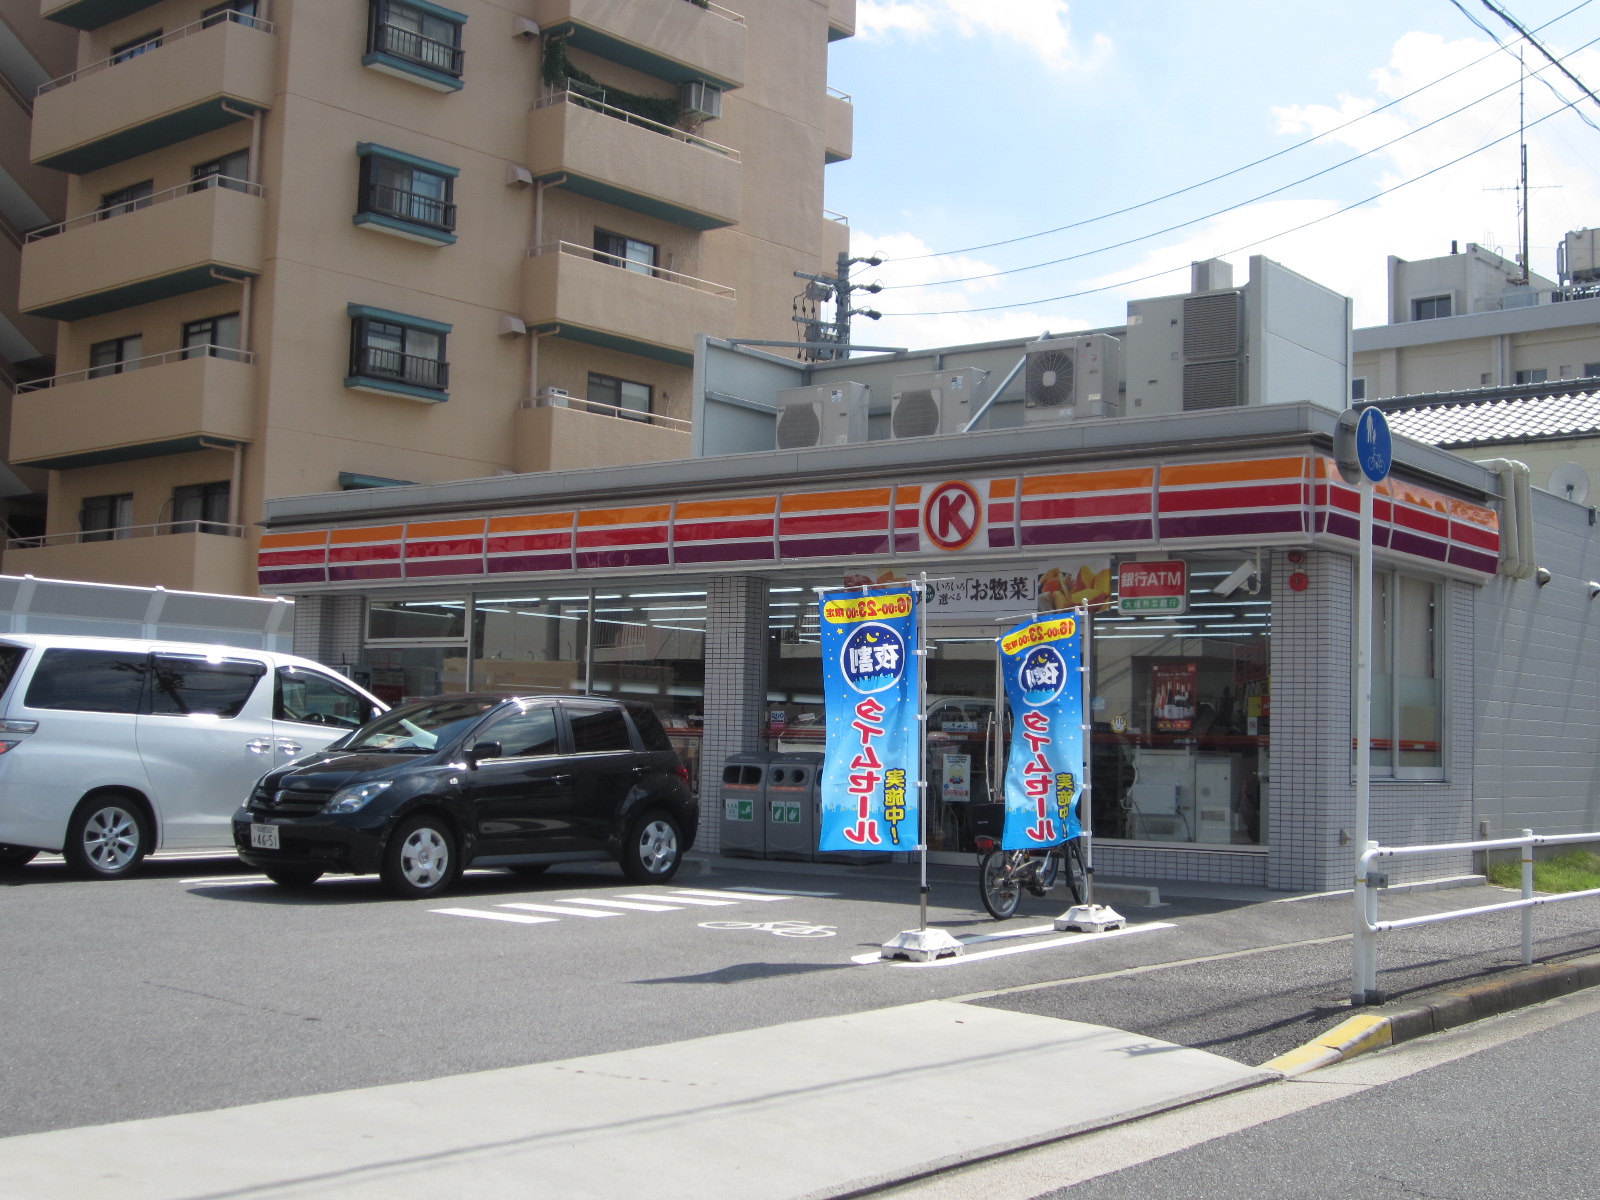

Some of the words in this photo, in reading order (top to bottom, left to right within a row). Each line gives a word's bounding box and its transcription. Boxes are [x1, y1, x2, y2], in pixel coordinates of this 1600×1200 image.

[938, 493, 973, 540] K
[1121, 571, 1181, 587] 銀行ATM
[936, 581, 966, 592] いろいろ
[938, 593, 961, 605] 選べる
[771, 712, 784, 720] QUO
[257, 833, 277, 848] 46-51
